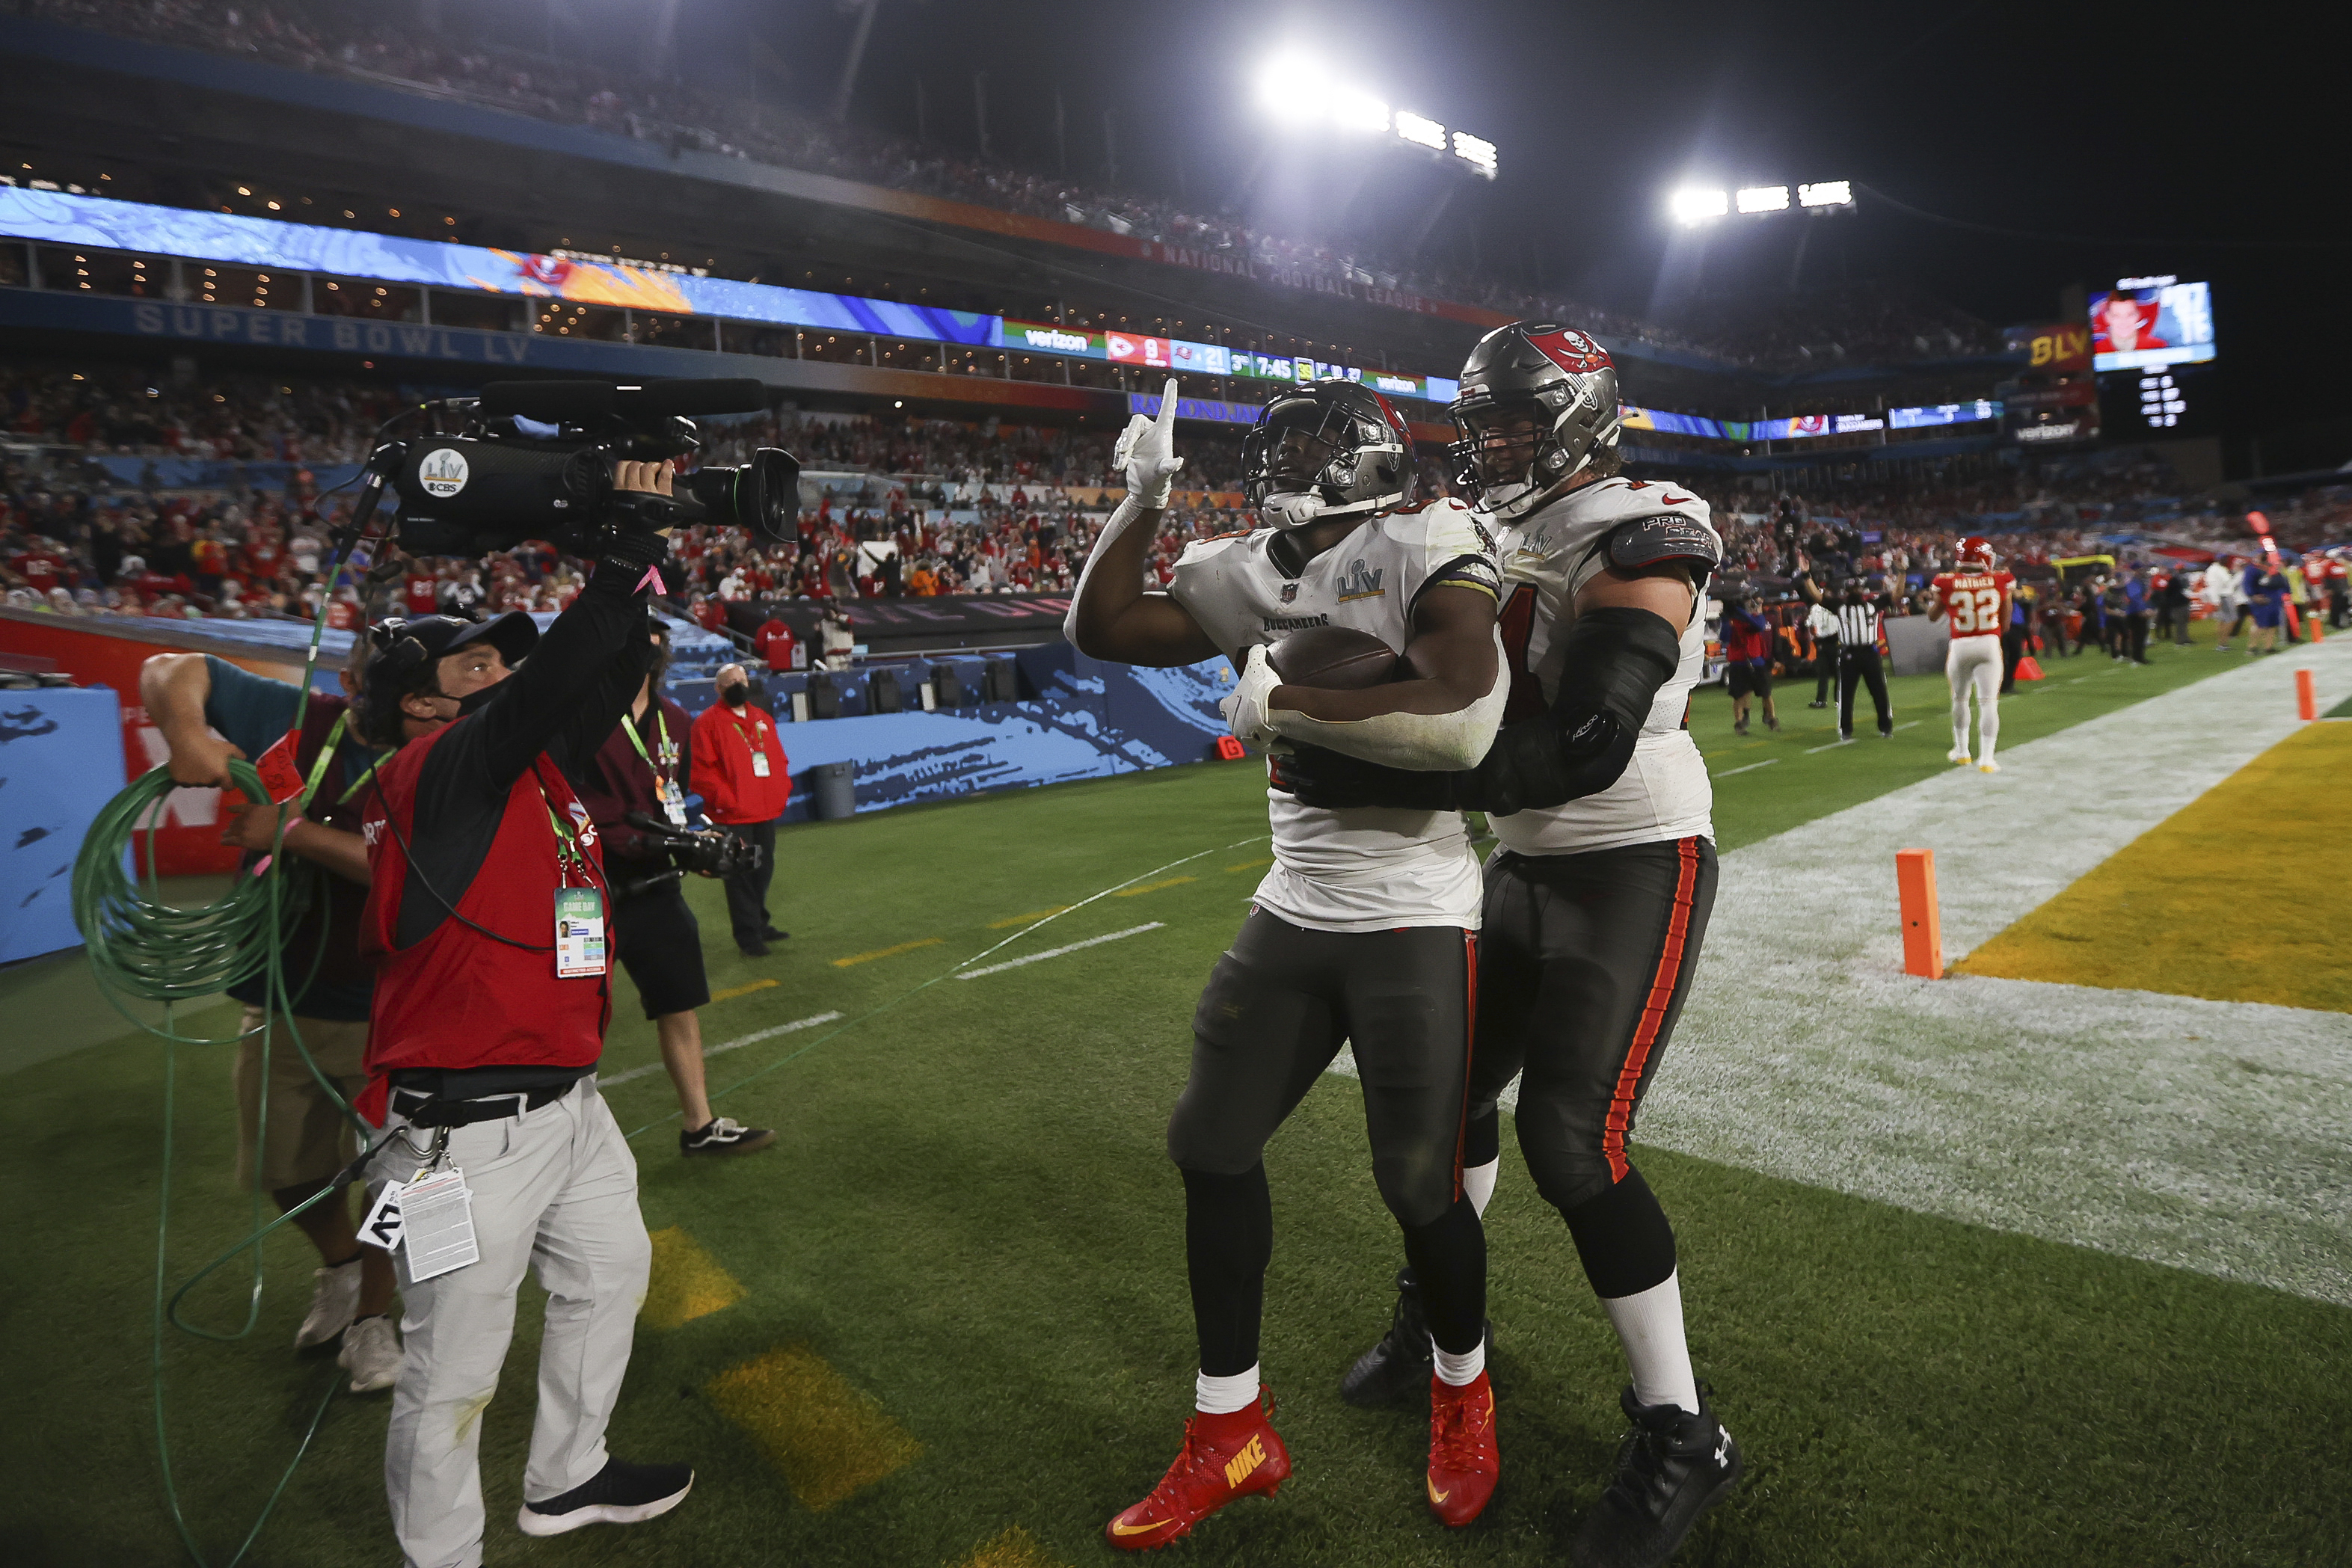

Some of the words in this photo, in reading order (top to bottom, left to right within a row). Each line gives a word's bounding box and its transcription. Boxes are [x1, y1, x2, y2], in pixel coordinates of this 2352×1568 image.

[1164, 243, 1258, 280] NATIONAL
[1366, 286, 1422, 311] LEAGUE
[135, 303, 306, 345] SUPER
[334, 322, 460, 358] BOWL
[486, 336, 529, 362] LV
[1025, 329, 1088, 351] verizon
[1144, 338, 1158, 360] 9
[1206, 347, 1223, 366] 21
[1257, 356, 1292, 379] 7:45
[1375, 376, 1417, 394] verizon
[437, 483, 457, 493] CBS
[1642, 515, 1686, 532] PRO
[1949, 588, 2001, 630] 32
[1263, 612, 1329, 633] BUCCANEERS
[1225, 739, 1239, 756] G
[1224, 1433, 1267, 1489] NIKE
